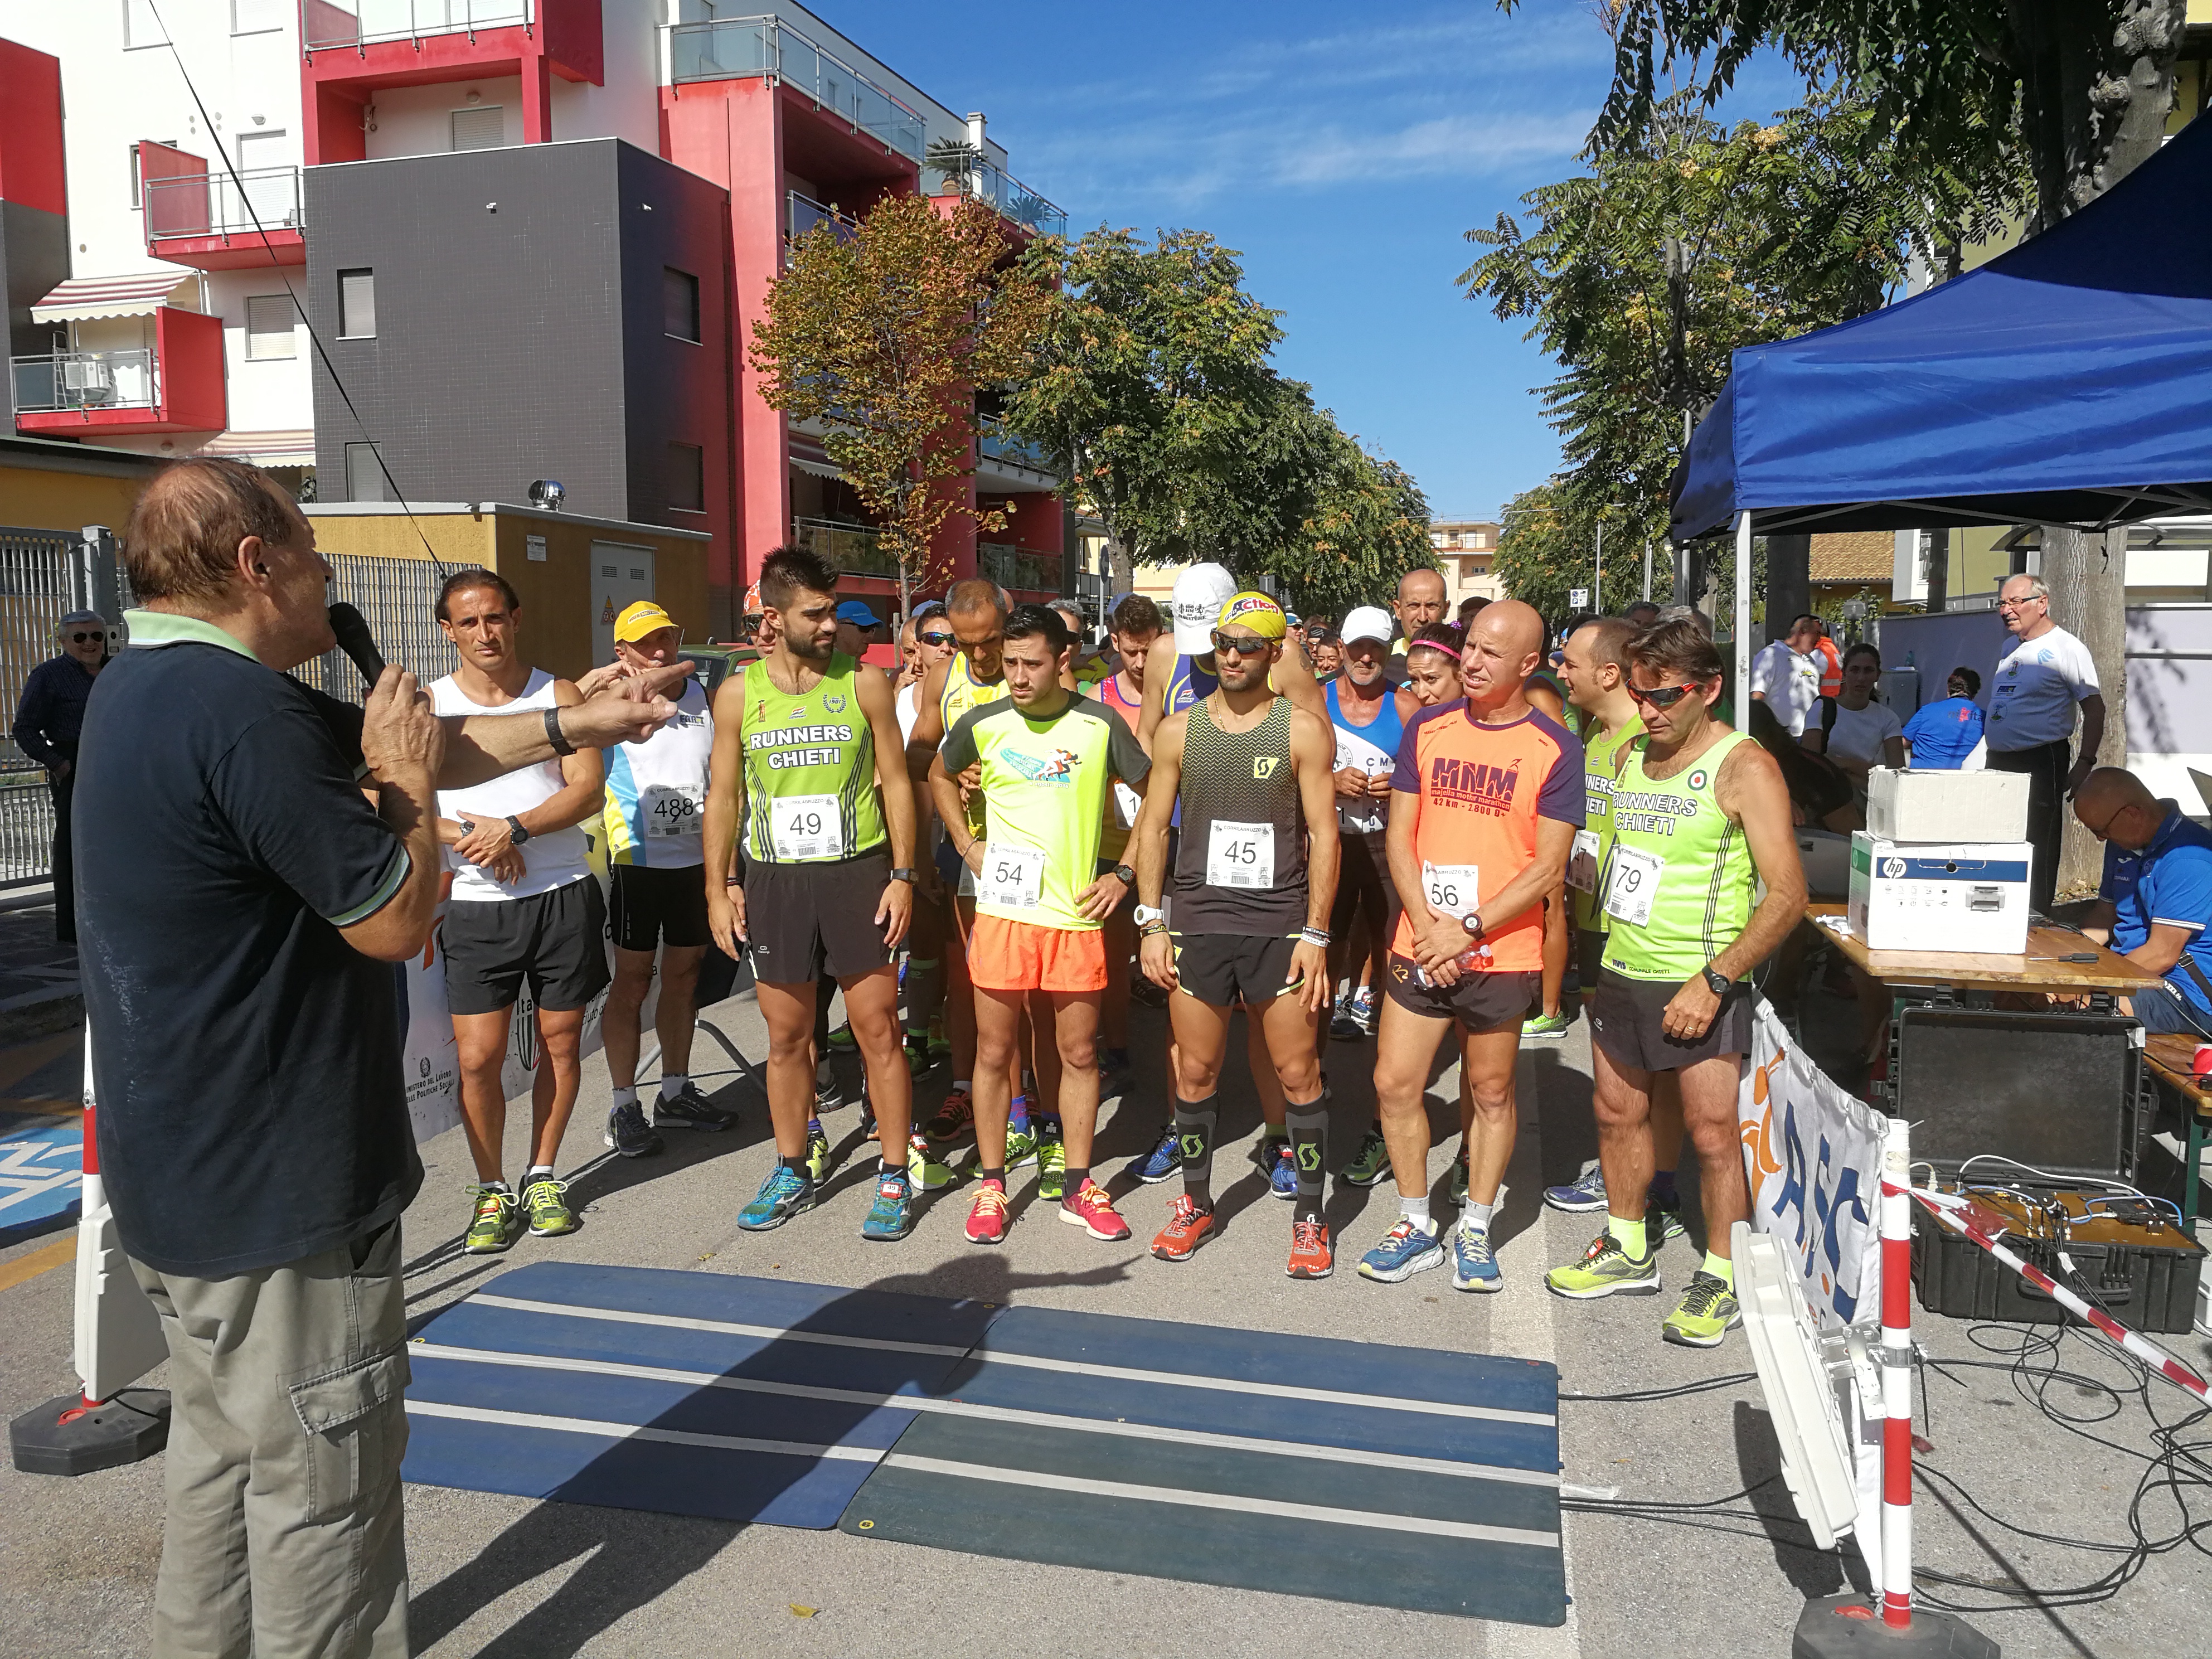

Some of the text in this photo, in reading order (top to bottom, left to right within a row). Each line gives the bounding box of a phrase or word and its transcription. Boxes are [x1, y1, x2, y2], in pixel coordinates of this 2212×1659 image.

[750, 725, 852, 750] RUNNERS
[768, 748, 840, 770] CHIETI
[1432, 788, 1455, 797] majella
[1478, 797, 1510, 810] marathon
[1446, 799, 1458, 808] km
[1468, 804, 1491, 816] 2.800
[1613, 792, 1697, 817] RUNNERS
[790, 813, 821, 835] 49
[1615, 812, 1676, 836] CHIETI
[1225, 841, 1256, 864] 45
[1575, 846, 1587, 867] 47
[996, 862, 1022, 885] 54
[1616, 864, 1641, 892] 79
[1886, 857, 1903, 879] hp
[1432, 883, 1458, 906] 56
